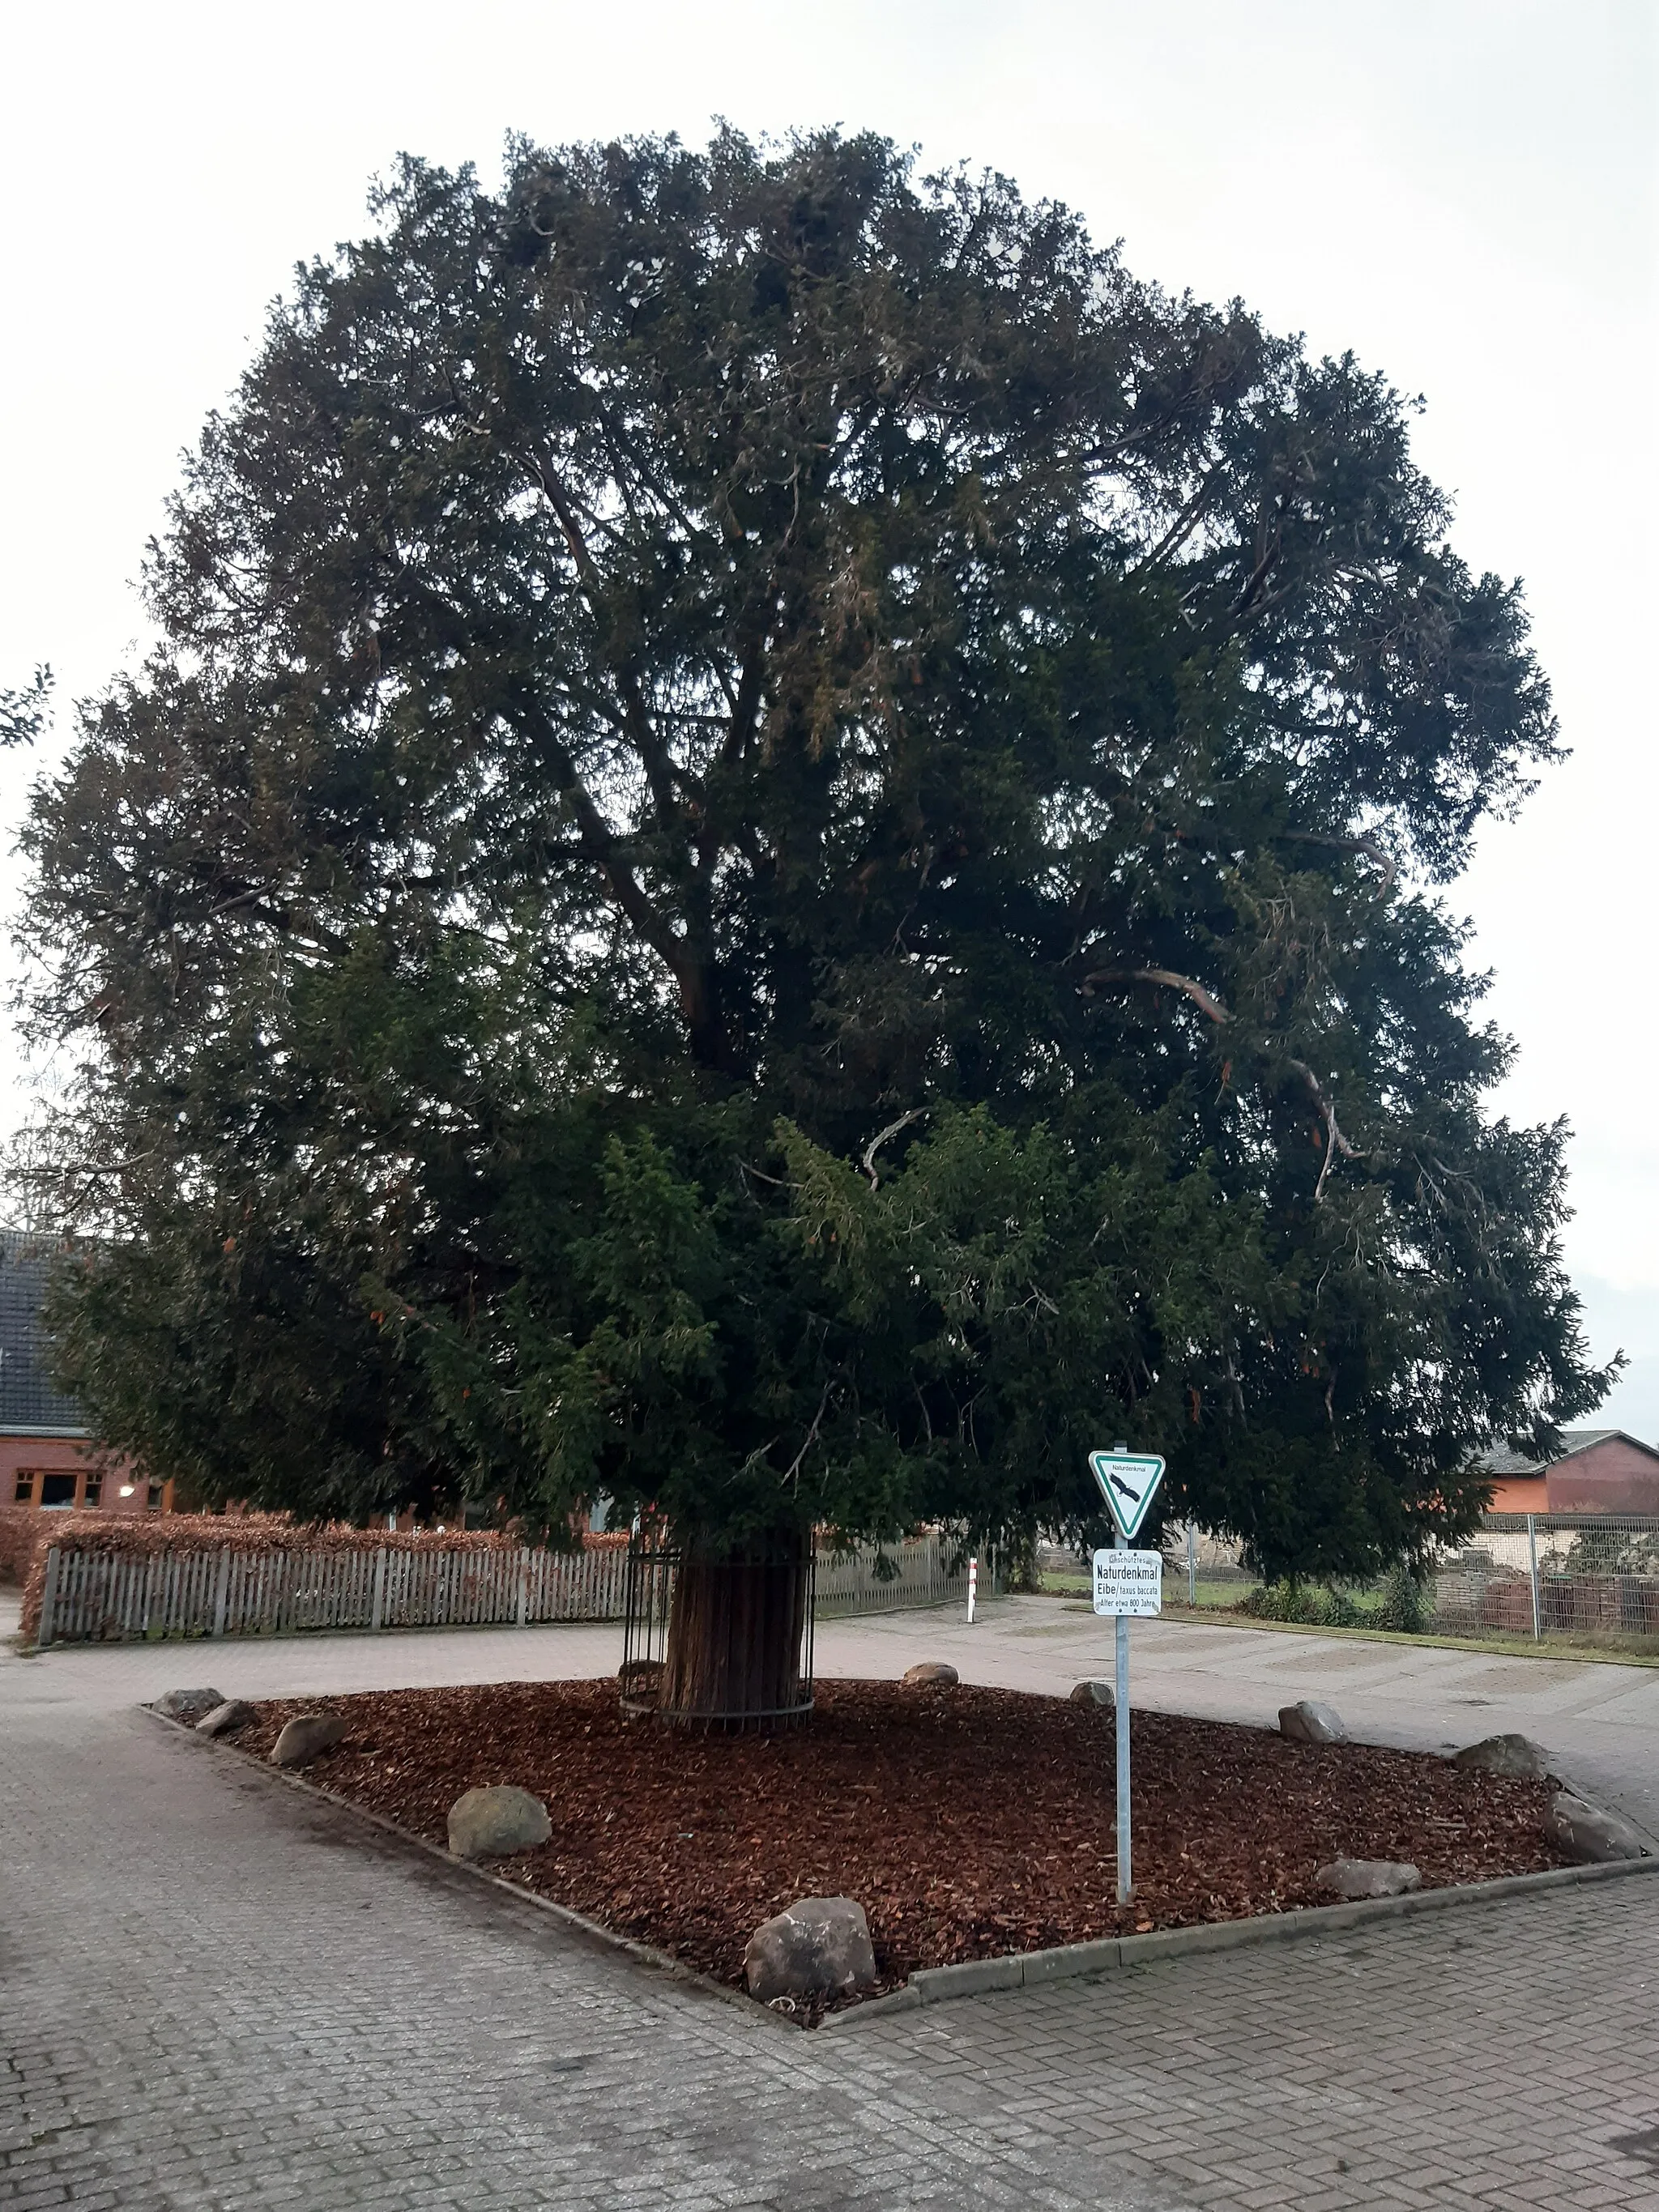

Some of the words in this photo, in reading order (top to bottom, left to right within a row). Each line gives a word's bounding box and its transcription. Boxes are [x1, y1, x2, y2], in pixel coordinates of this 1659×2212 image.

[1112, 1464, 1146, 1473] Naturdenkmal
[1097, 1564, 1158, 1580] Naturdenkmal
[1137, 1585, 1158, 1595] baccata
[1100, 1598, 1114, 1607] Alter
